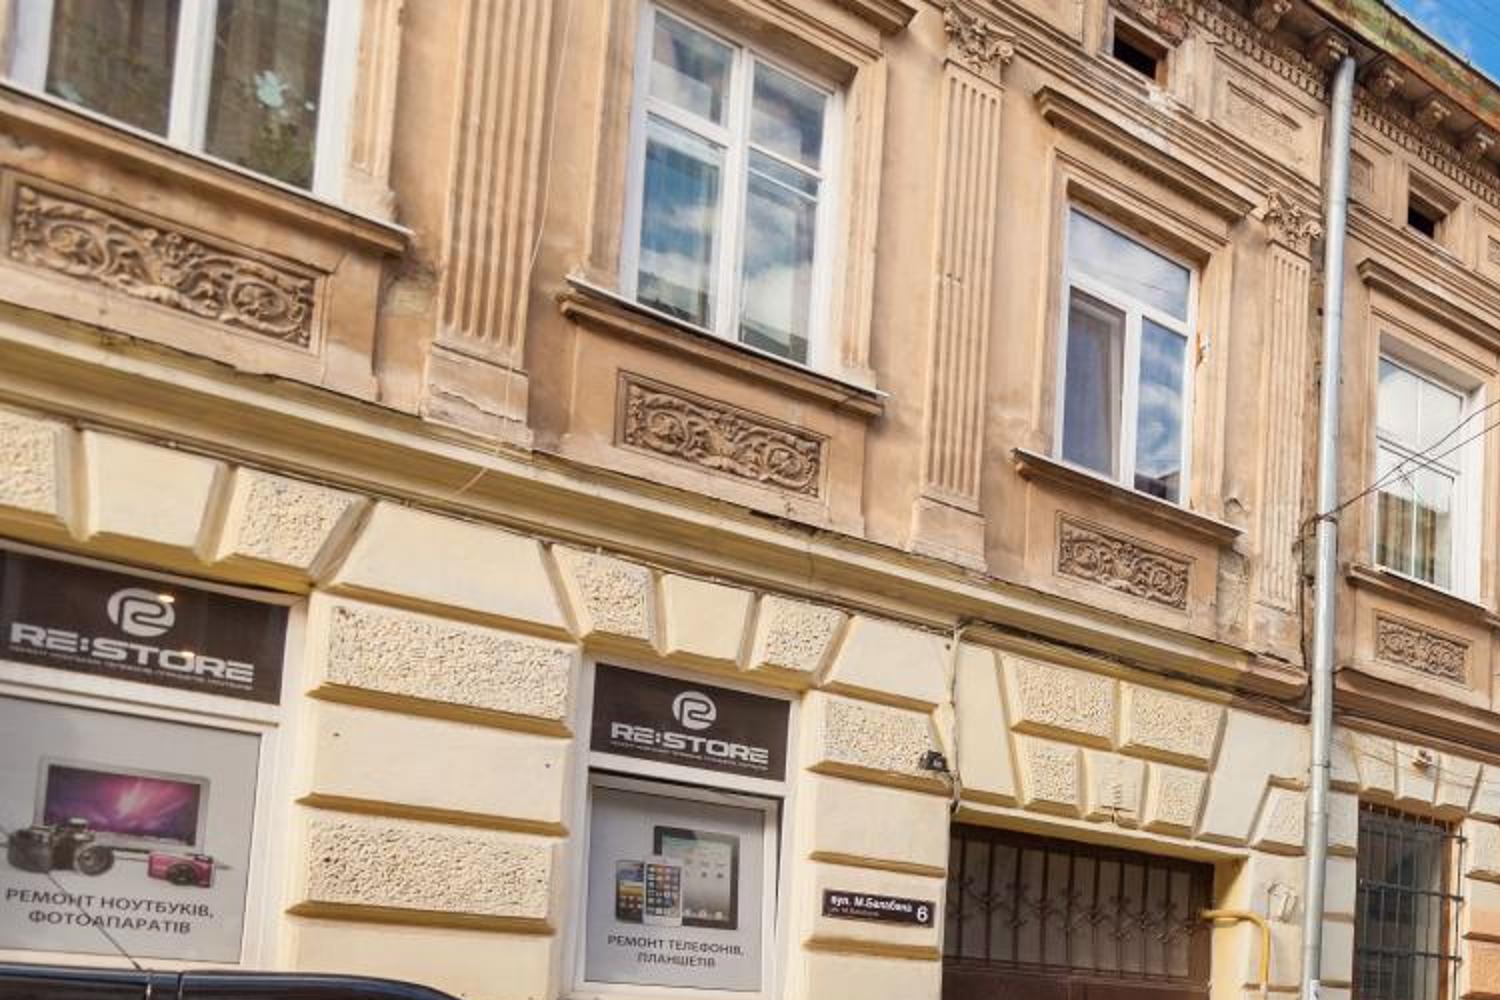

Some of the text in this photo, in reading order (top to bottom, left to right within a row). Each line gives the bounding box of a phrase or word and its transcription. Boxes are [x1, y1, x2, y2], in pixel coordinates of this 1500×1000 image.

[10, 622, 254, 683] RE:STORE
[611, 721, 768, 764] RE:STORE
[6, 888, 214, 918] РЕМОНТ НОУТБУКІВ,
[916, 905, 929, 922] 6
[28, 909, 191, 934] ФОТОАПАРАТІВ
[607, 935, 663, 949] РЕМОНТ
